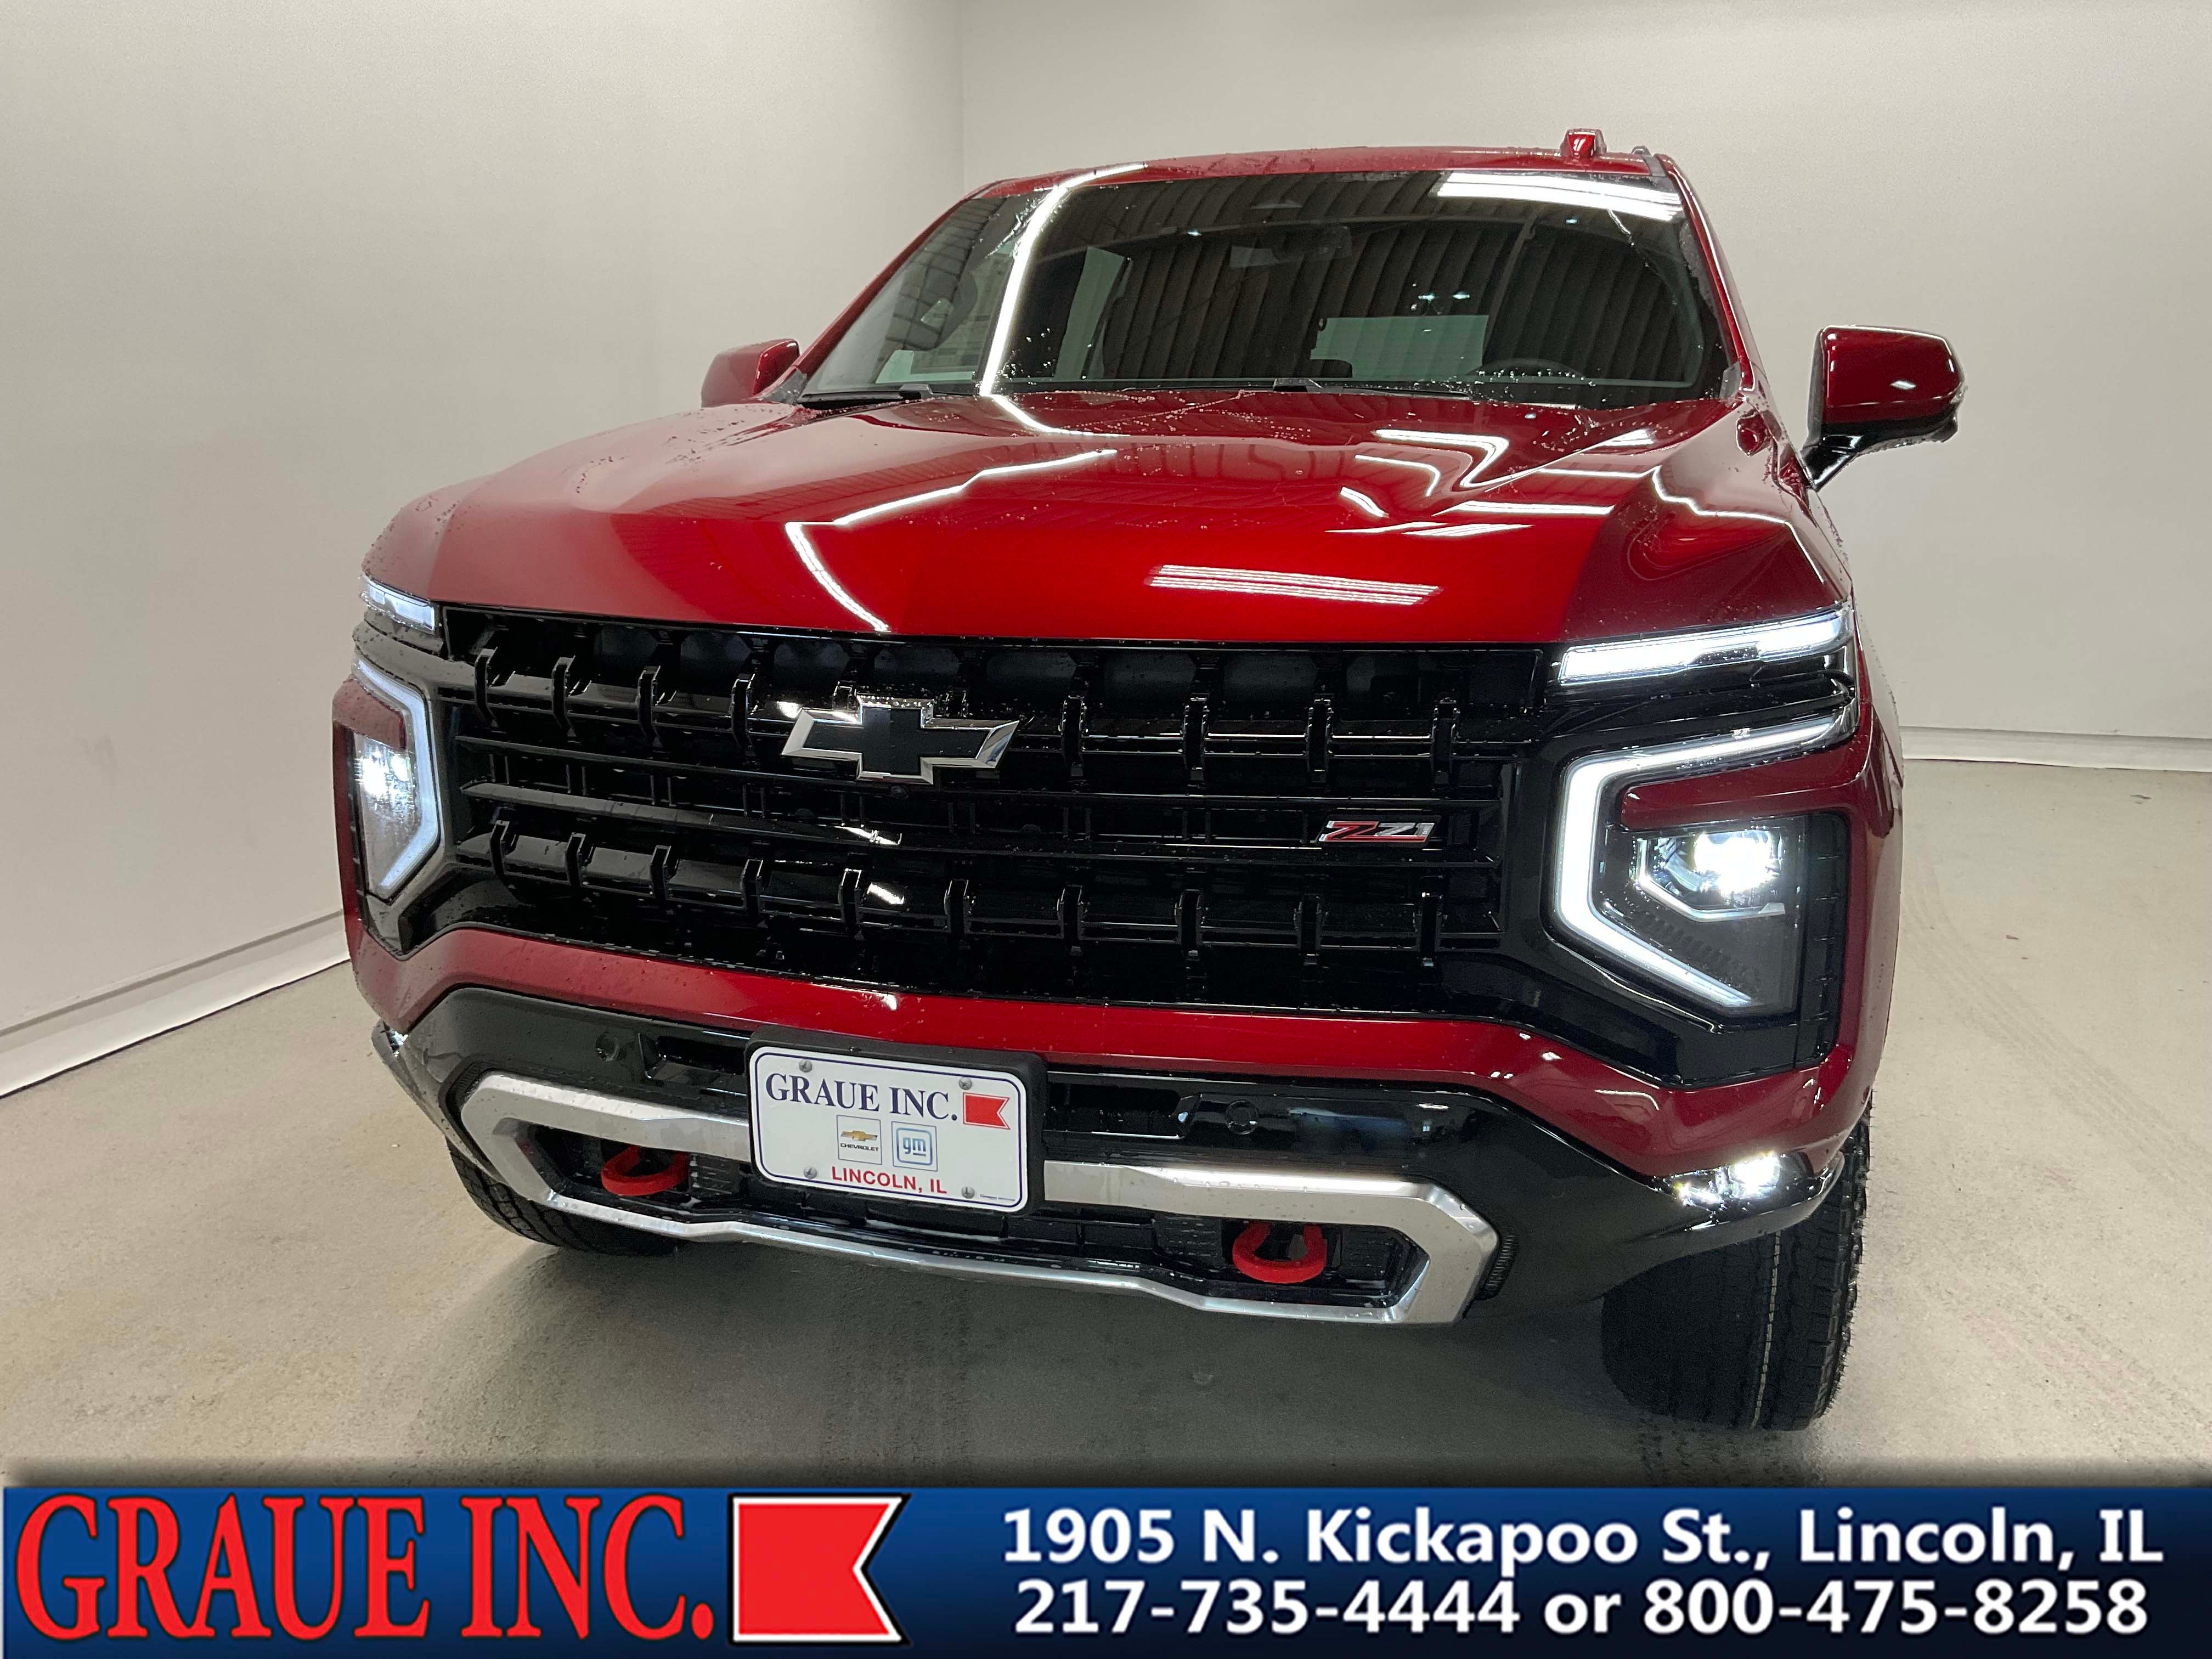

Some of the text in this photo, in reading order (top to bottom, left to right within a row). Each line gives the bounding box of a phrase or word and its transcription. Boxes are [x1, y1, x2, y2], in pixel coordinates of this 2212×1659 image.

[1318, 820, 1435, 843] Z71
[765, 1073, 957, 1121] GRAUE INC.
[840, 1142, 879, 1152] CHEVROLET
[832, 1166, 947, 1194] LINCOLN, IL
